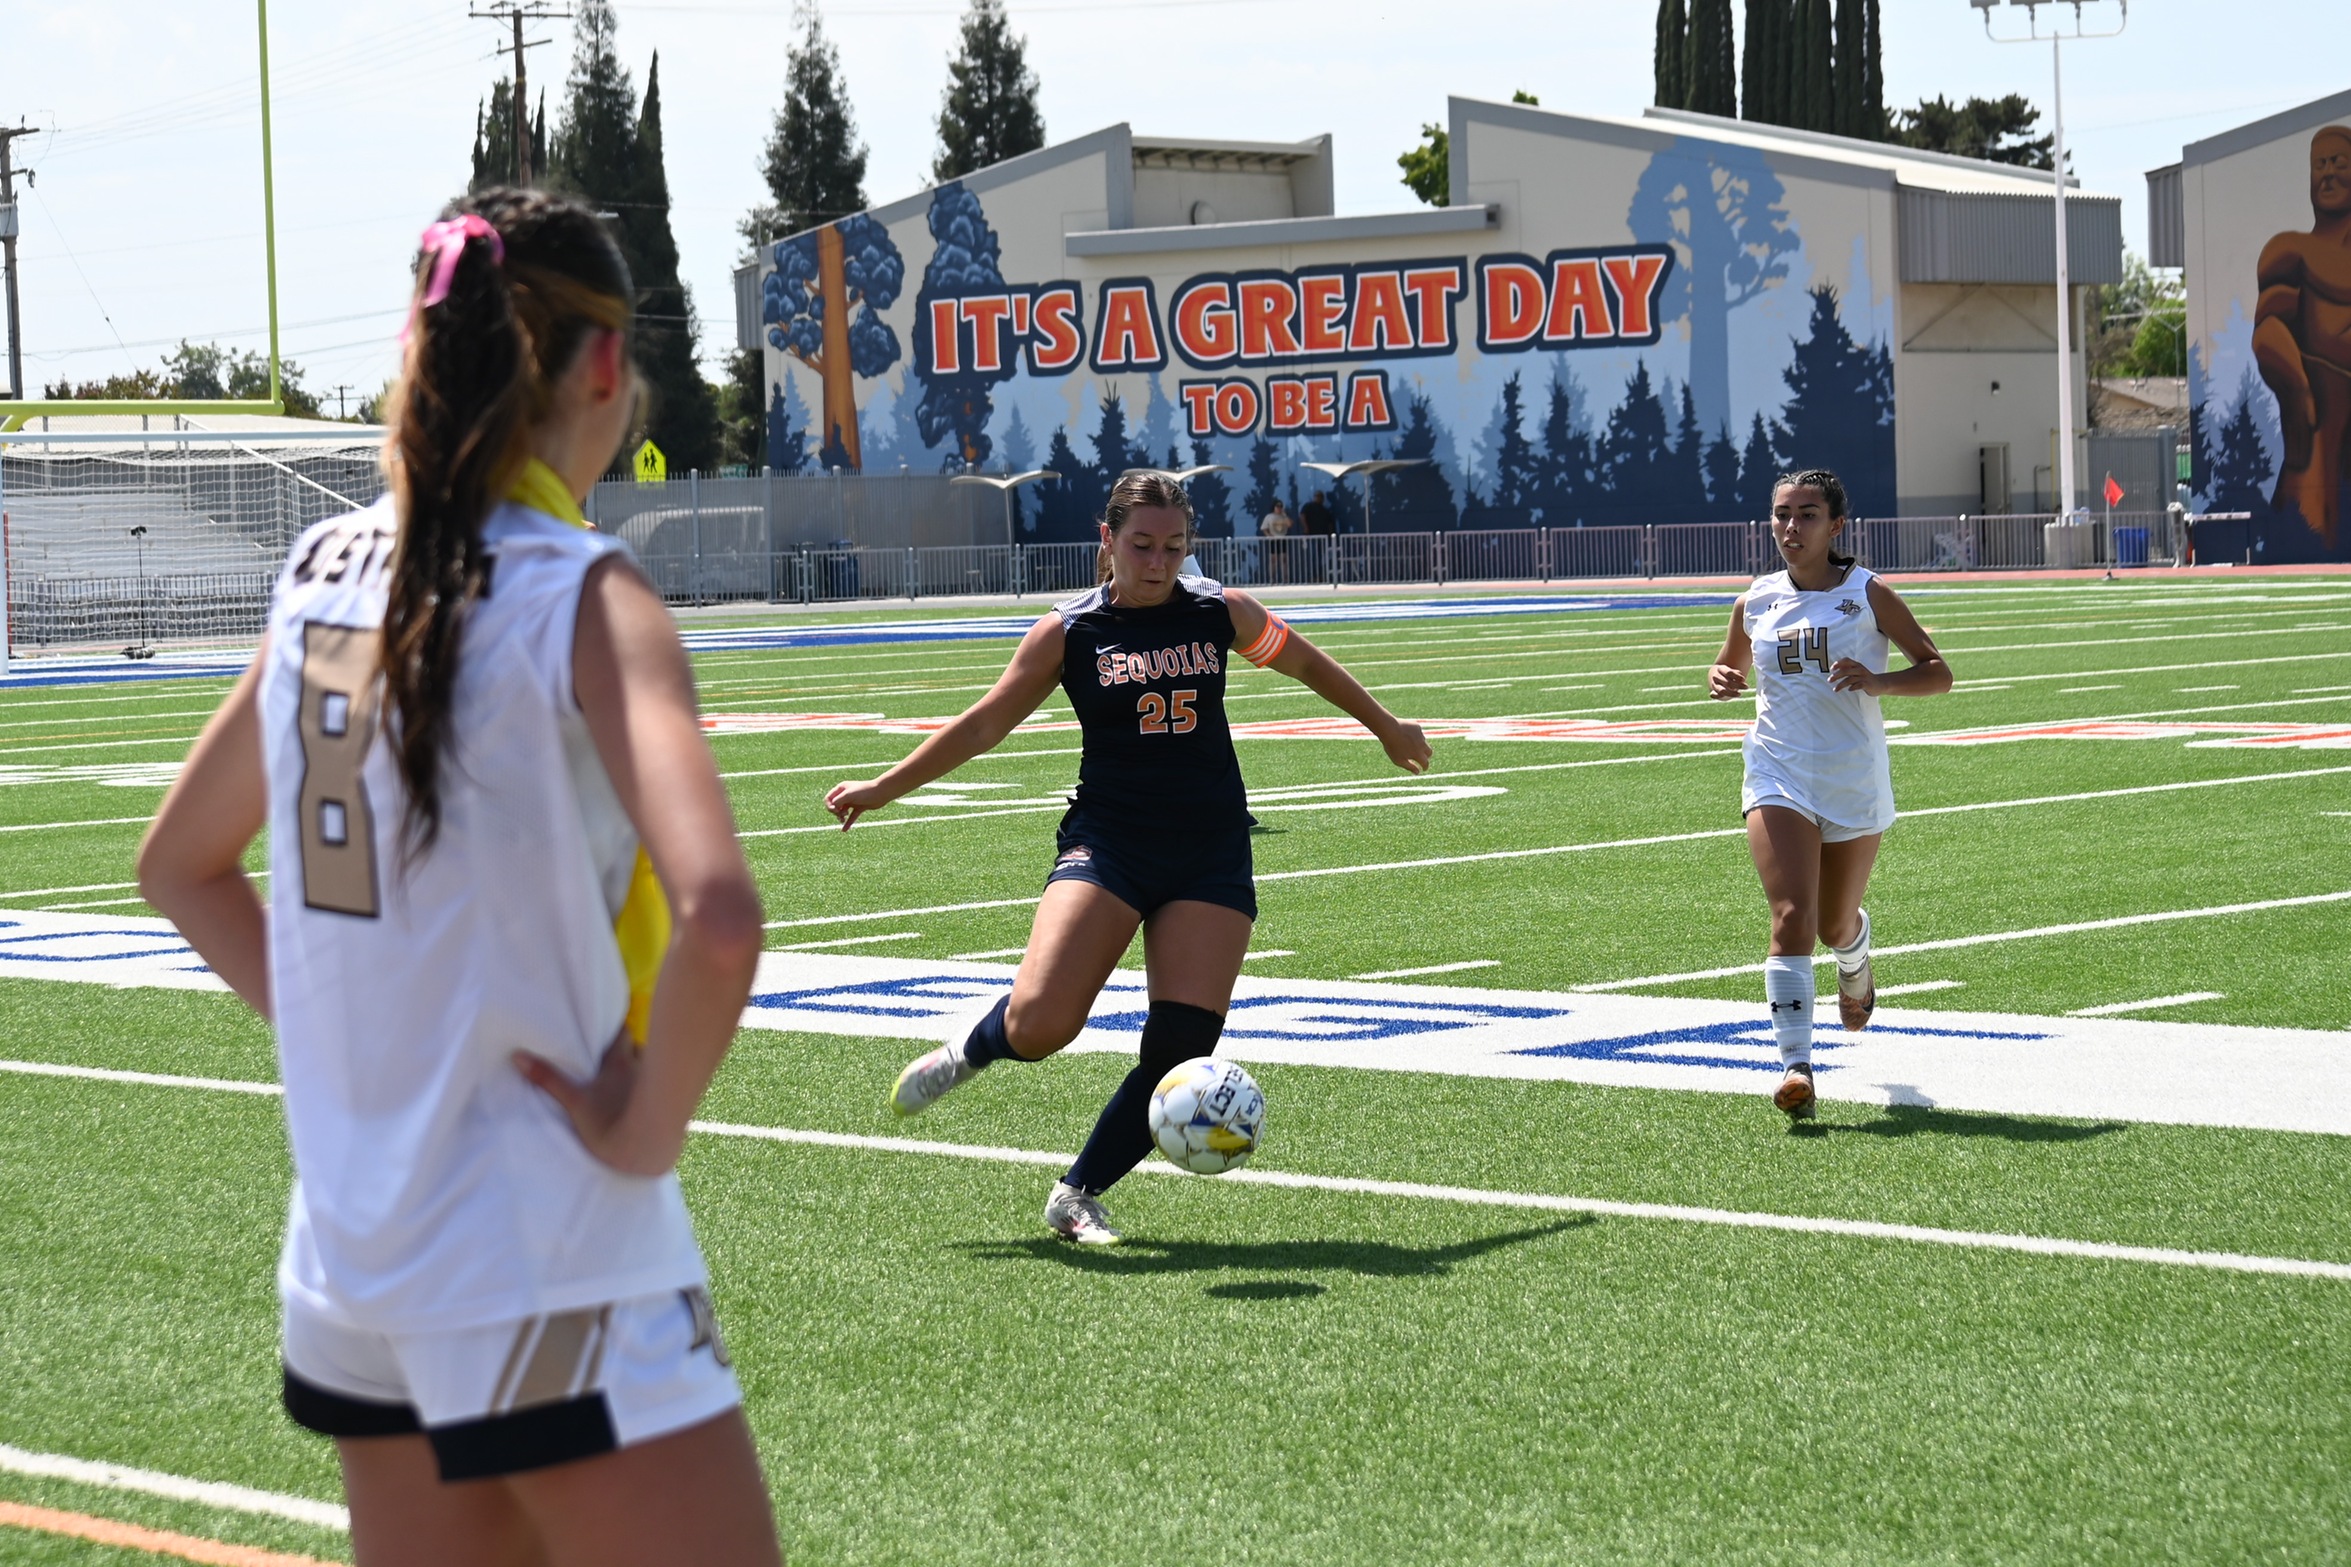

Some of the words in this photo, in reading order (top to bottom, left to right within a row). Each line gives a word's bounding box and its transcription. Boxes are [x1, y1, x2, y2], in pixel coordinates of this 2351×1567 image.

[930, 288, 1076, 374] IT'S
[1097, 285, 1161, 364] A
[1175, 265, 1461, 361] GREAT
[1483, 254, 1667, 345] DAY
[1183, 381, 1258, 433] TO
[1269, 377, 1336, 428] BE
[1347, 374, 1391, 425] A
[1096, 641, 1220, 687] SEQUOIAS
[1776, 626, 1830, 675] 24
[1136, 689, 1198, 735] 25
[297, 619, 383, 919] 8
